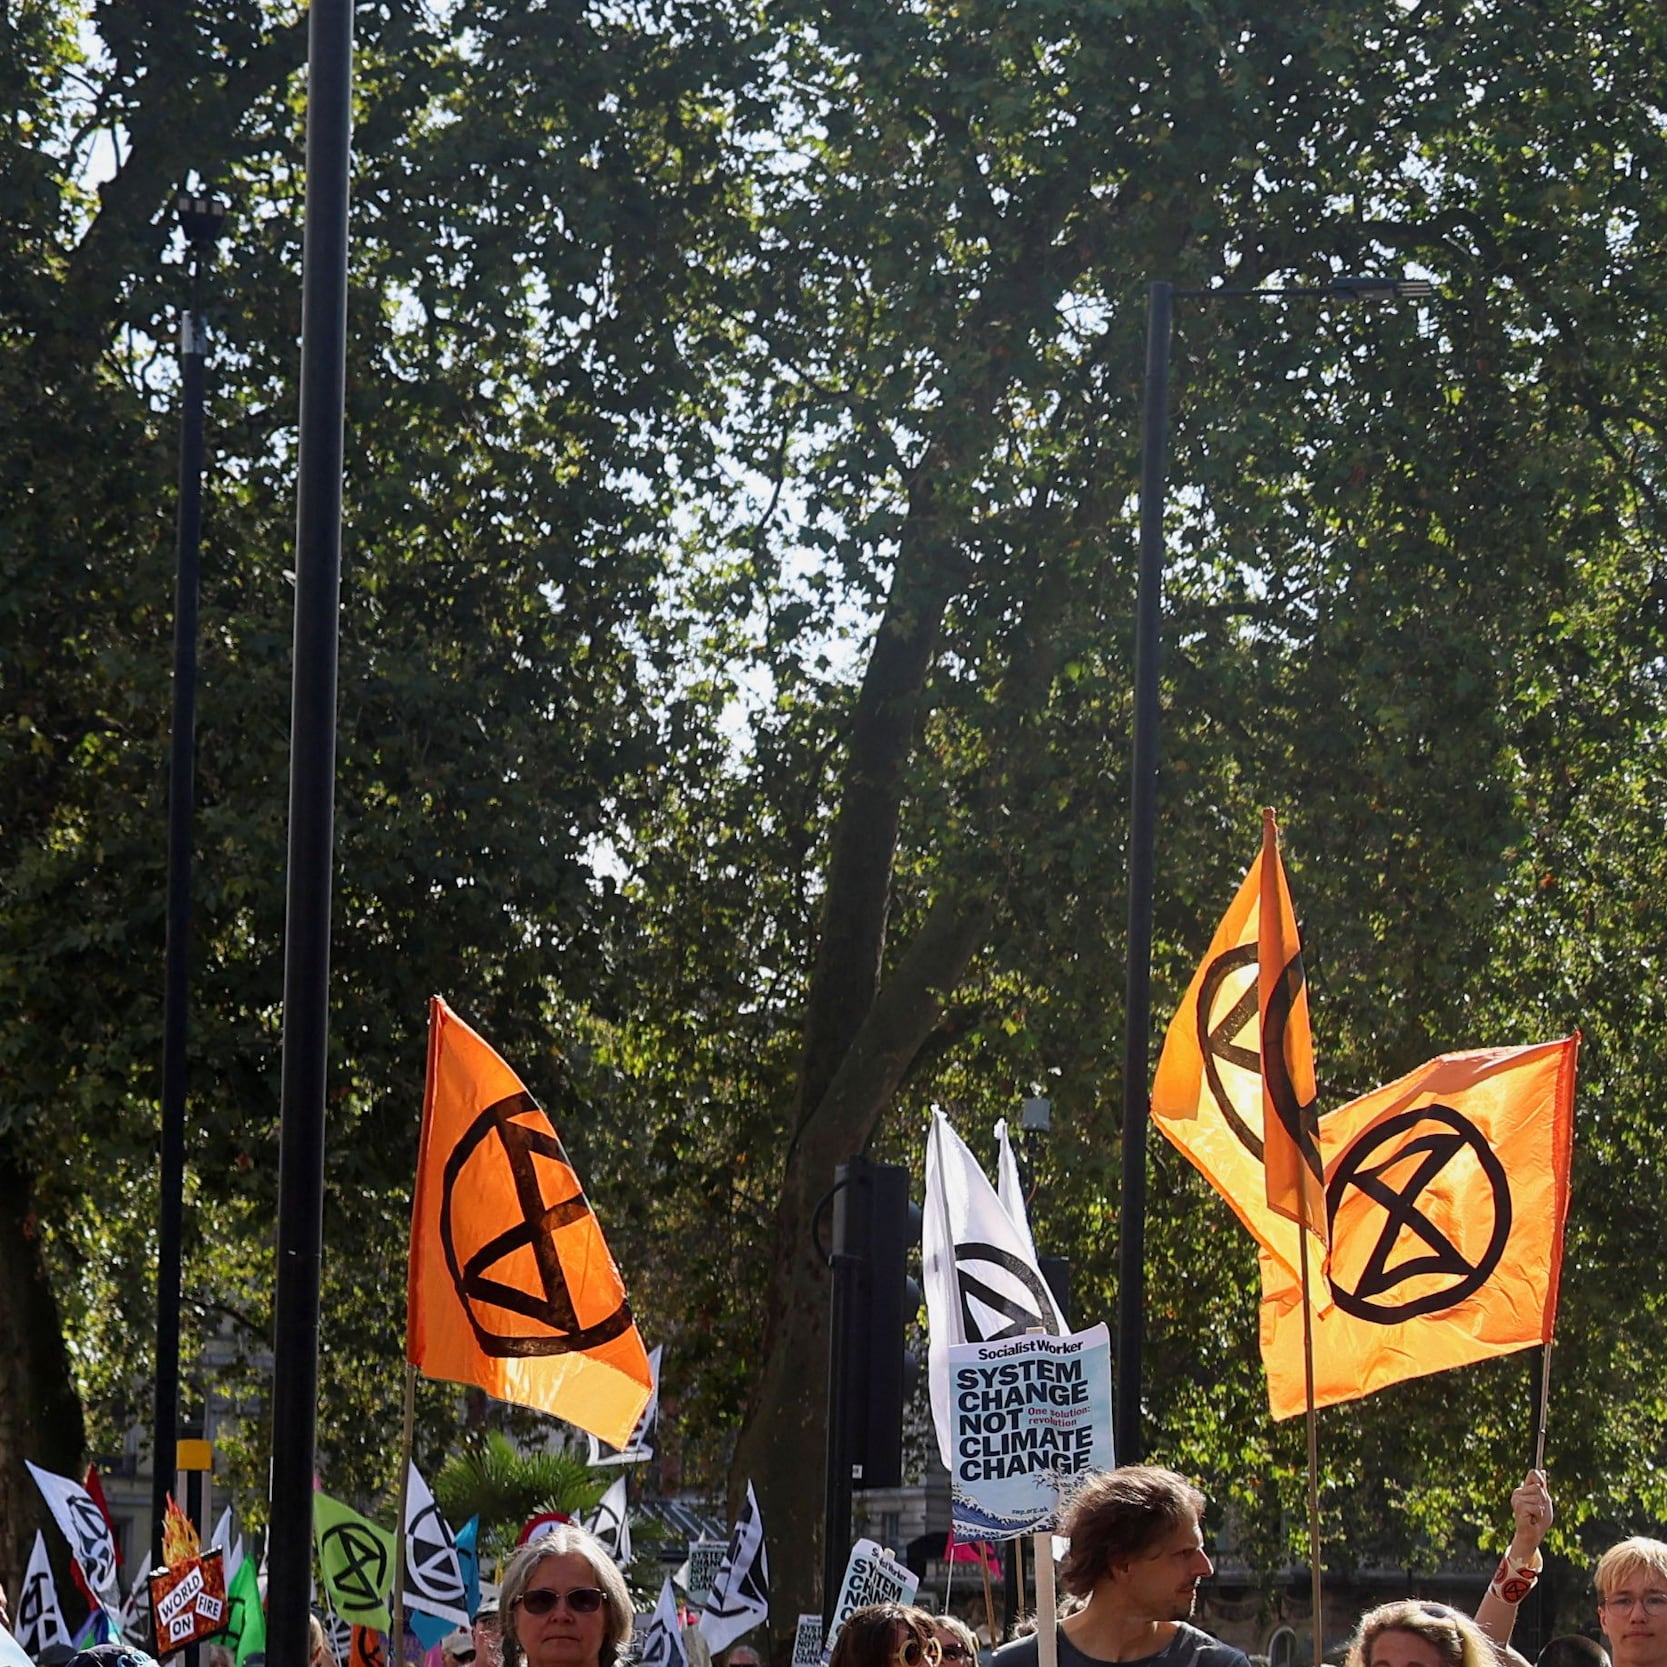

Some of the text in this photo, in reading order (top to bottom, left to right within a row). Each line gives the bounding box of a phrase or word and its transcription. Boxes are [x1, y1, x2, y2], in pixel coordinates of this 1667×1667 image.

[978, 1339, 1083, 1360] Socialist Worker
[957, 1359, 1082, 1390] SYSTEM
[958, 1380, 1089, 1413] CHANGE
[959, 1408, 1024, 1436] NOT
[1028, 1407, 1048, 1416] One
[1028, 1416, 1078, 1427] revolution
[959, 1425, 1094, 1459] CLIMATE
[959, 1449, 1092, 1482] CHANGE
[852, 1558, 903, 1602] SYTEM
[161, 1575, 200, 1619] WORLD
[198, 1596, 219, 1617] FIRE
[843, 1590, 871, 1607] NO
[172, 1616, 192, 1636] ON
